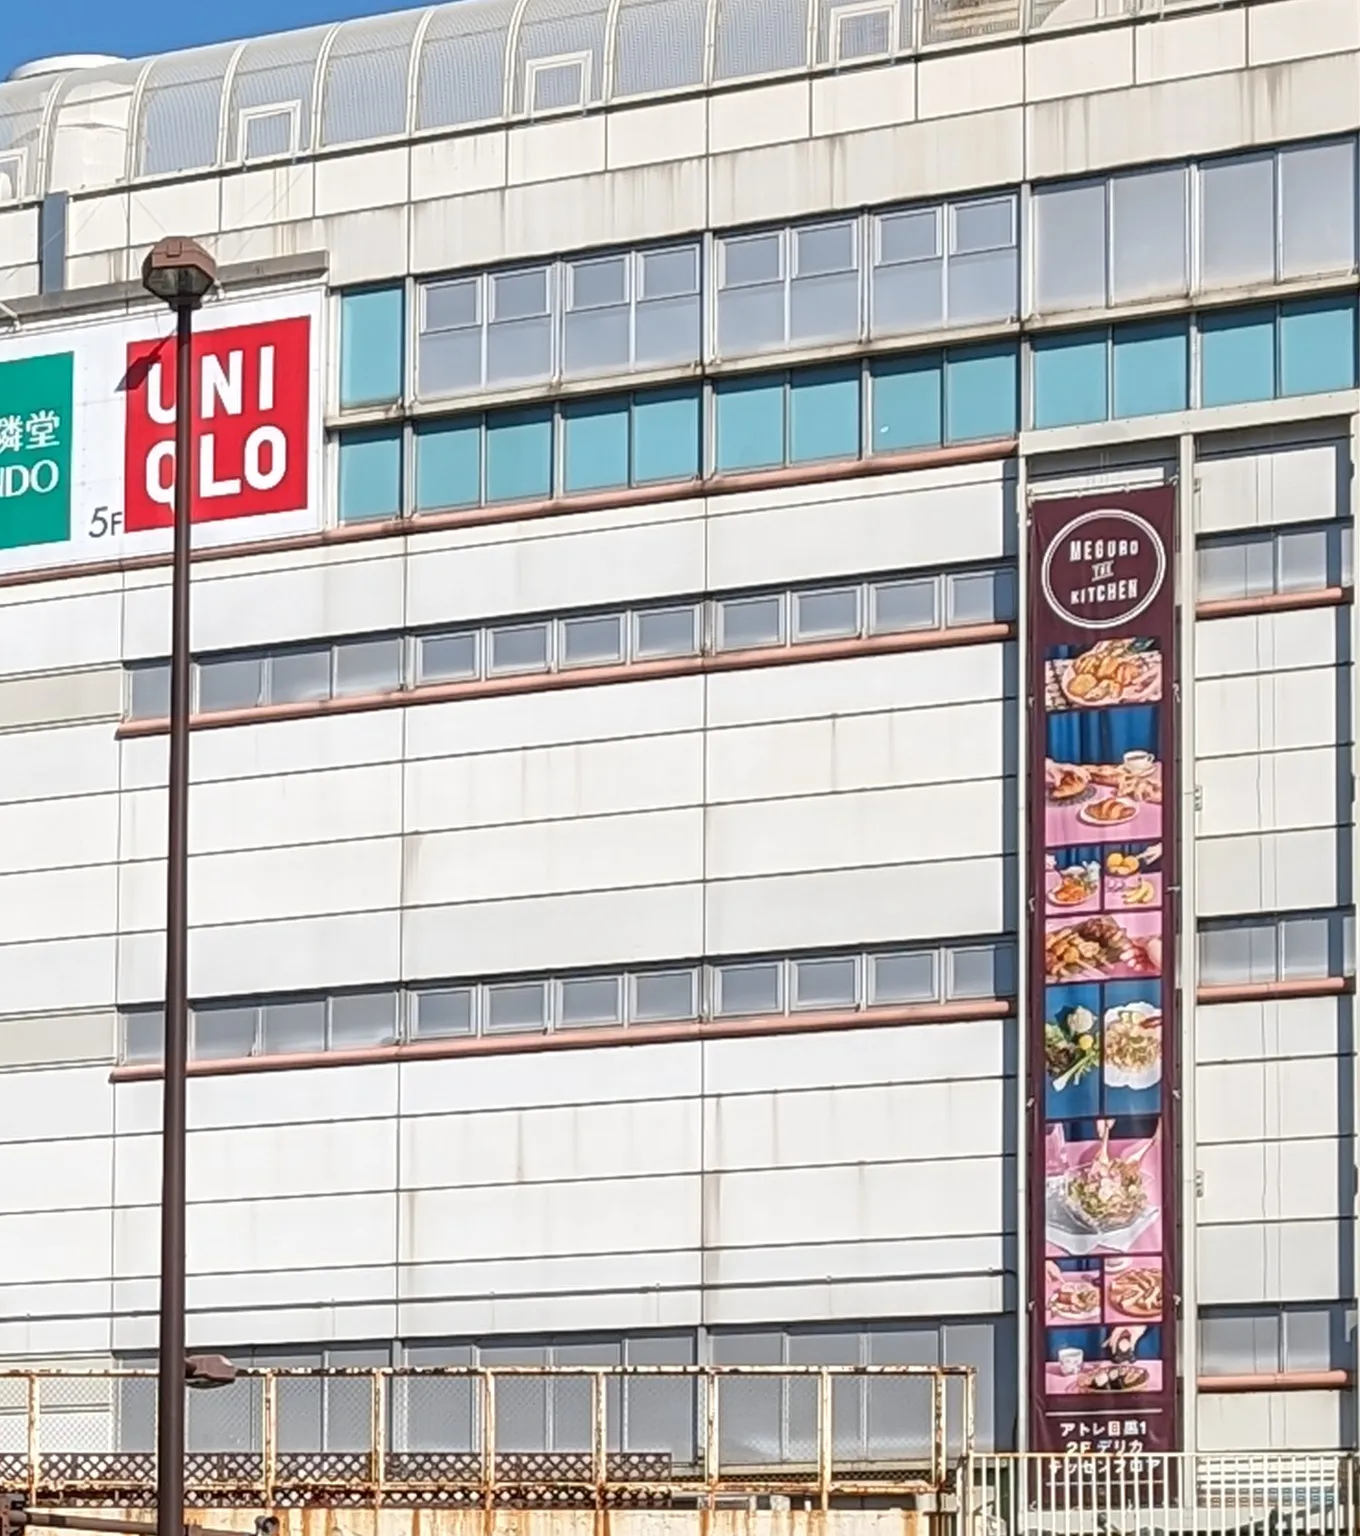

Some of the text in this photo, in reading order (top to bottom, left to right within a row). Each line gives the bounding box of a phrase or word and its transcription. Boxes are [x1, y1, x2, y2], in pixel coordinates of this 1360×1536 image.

[88, 506, 123, 538] 5F
[1069, 540, 1139, 562] MEGURO
[1071, 579, 1138, 604] KITCHEN
